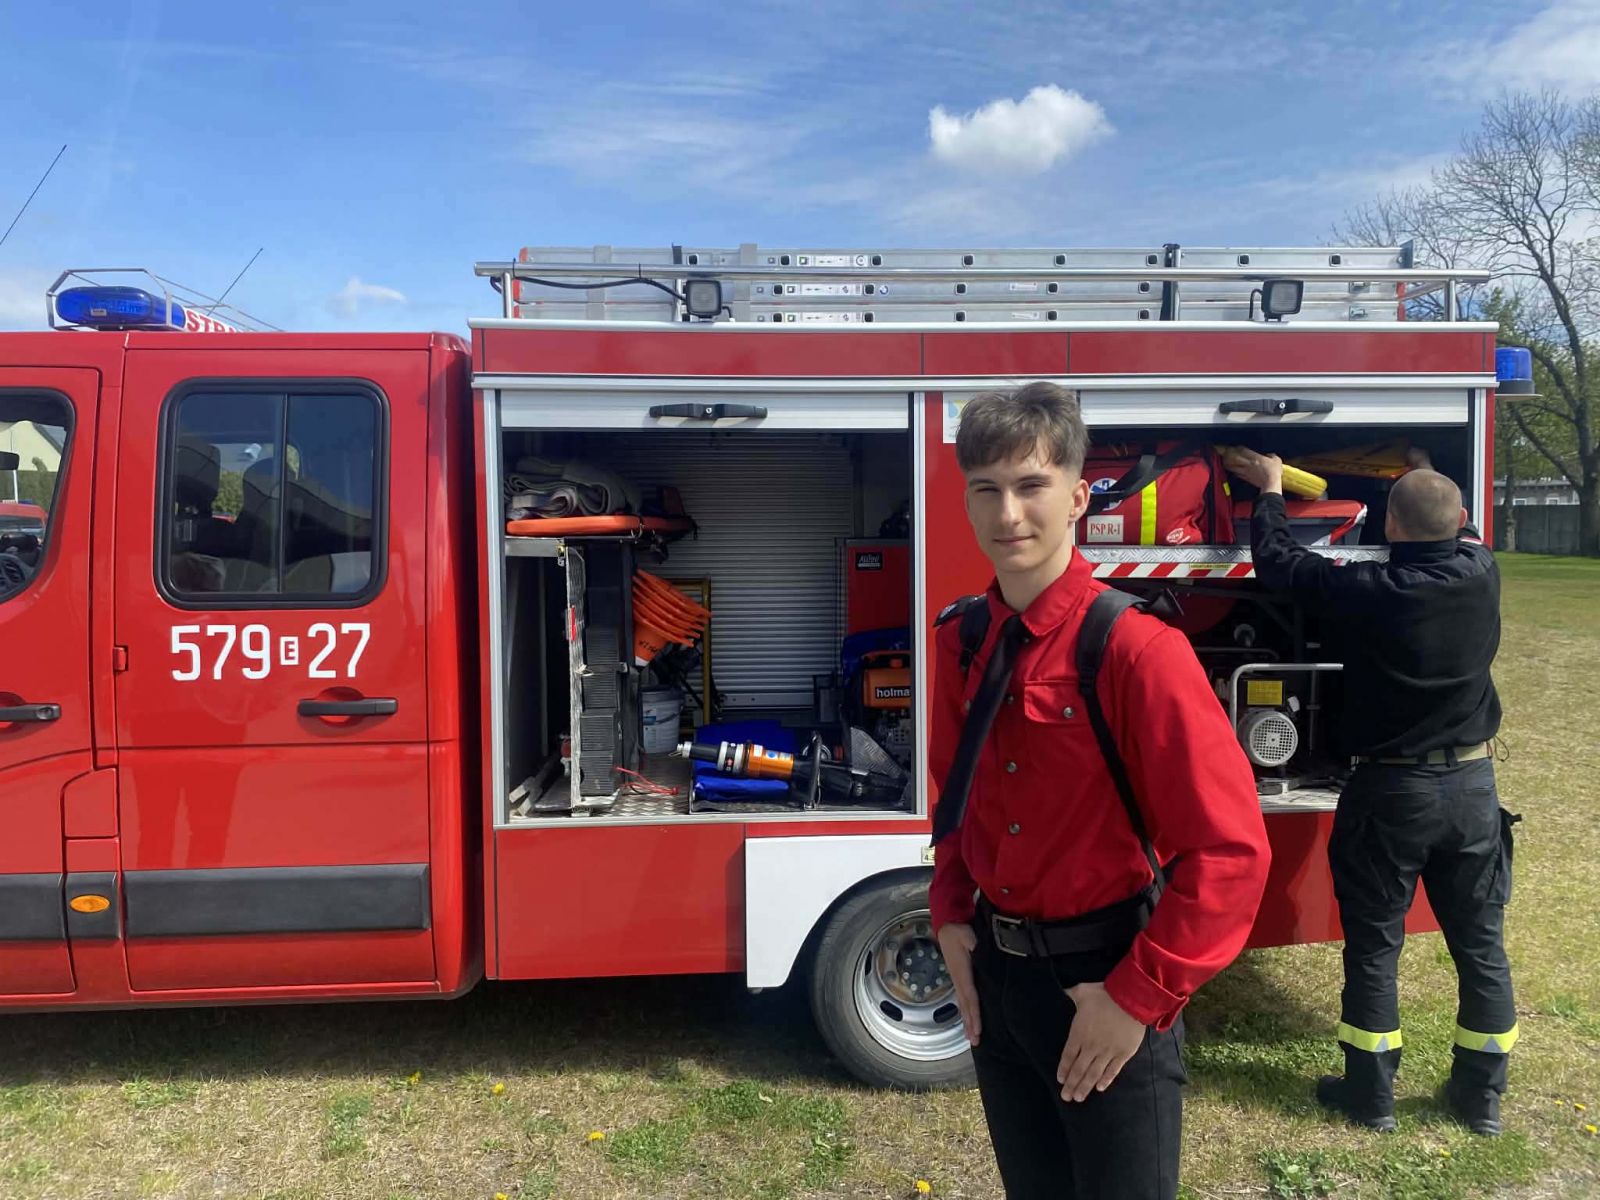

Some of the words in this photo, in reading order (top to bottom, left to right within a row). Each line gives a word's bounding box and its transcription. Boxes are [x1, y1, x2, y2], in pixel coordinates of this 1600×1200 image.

[1090, 523, 1106, 535] PSP
[171, 624, 271, 681] 579
[307, 622, 371, 679] 27
[876, 688, 911, 698] holma
